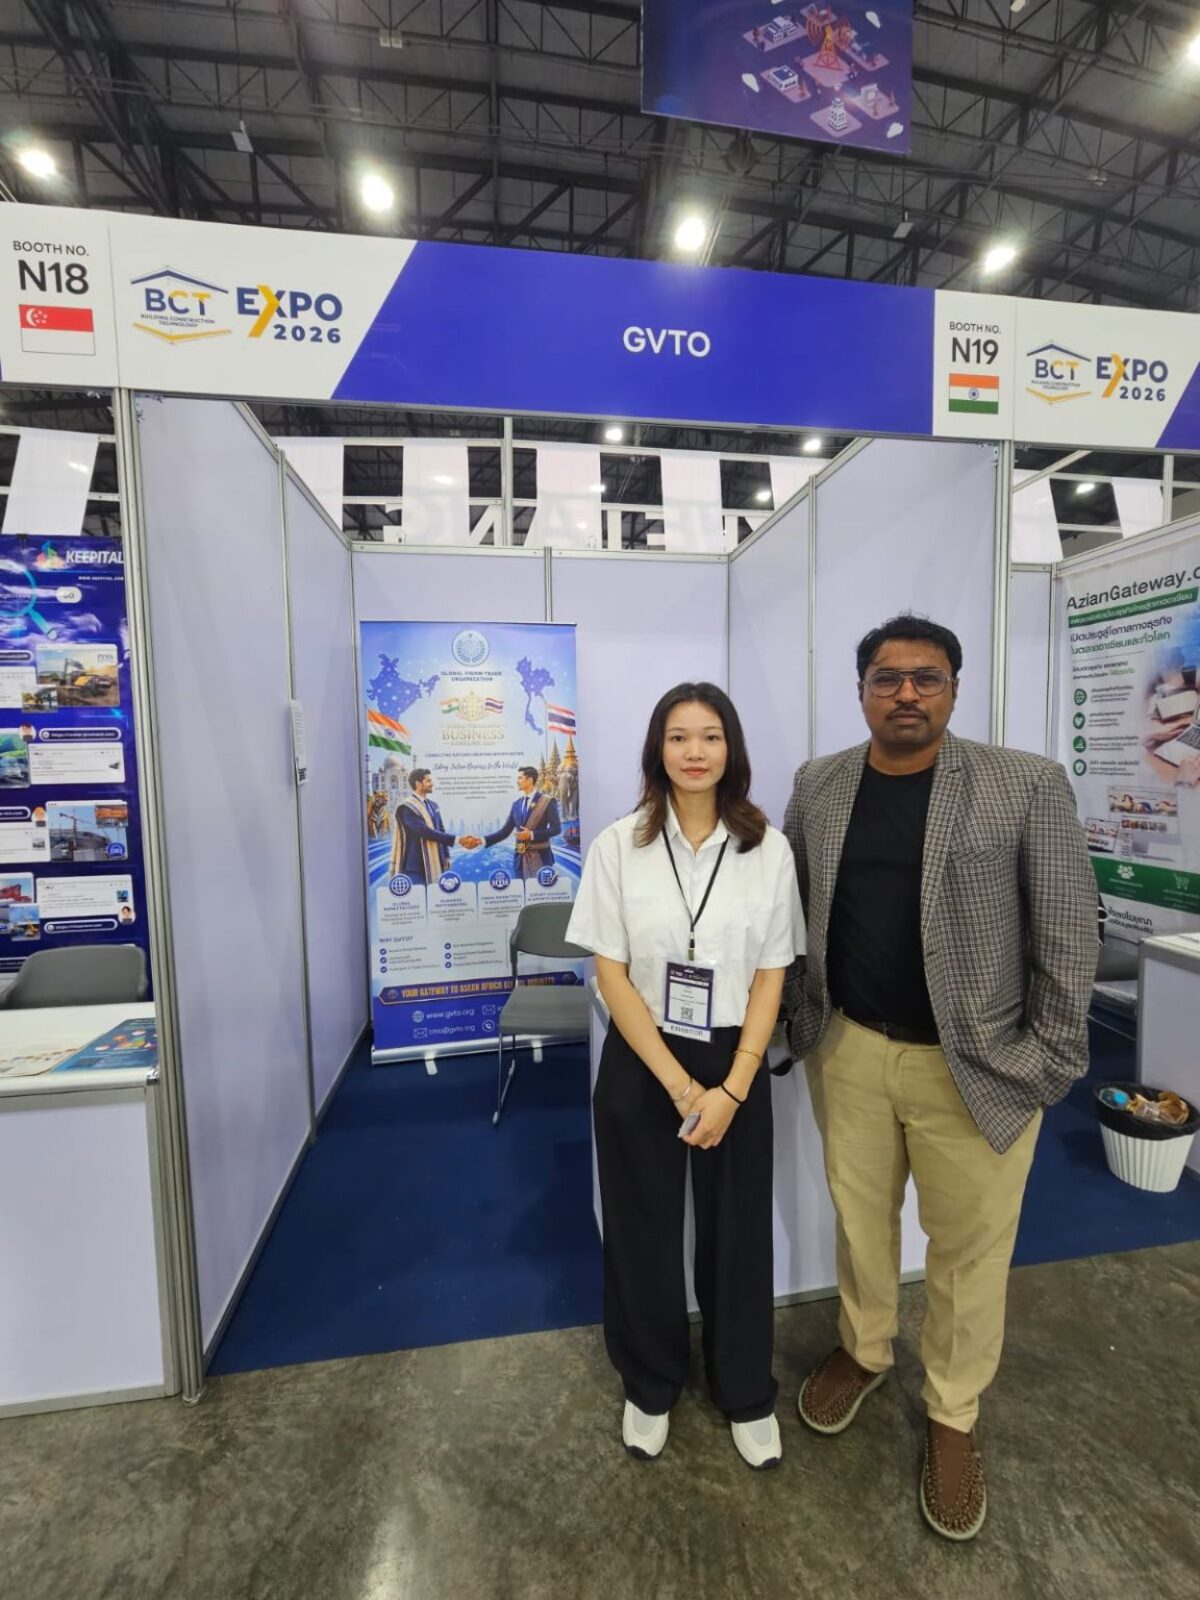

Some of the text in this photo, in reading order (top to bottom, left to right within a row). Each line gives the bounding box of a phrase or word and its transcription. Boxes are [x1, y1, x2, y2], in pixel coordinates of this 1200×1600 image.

[13, 240, 90, 256] BOOTH NO.
[18, 259, 89, 294] N18
[145, 287, 211, 316] BCT
[236, 284, 343, 337] EXPO
[273, 324, 342, 343] 2026
[949, 321, 1002, 335] BOOTH NO.
[622, 326, 711, 358] GVTO
[951, 337, 999, 365] N19
[1035, 359, 1080, 380] BCT
[1096, 353, 1168, 398] EXPO
[1119, 386, 1166, 402] 2026
[66, 550, 124, 563] KEEPITAL
[442, 729, 504, 740] BUSINESS
[426, 1009, 475, 1019] www.gvto.org
